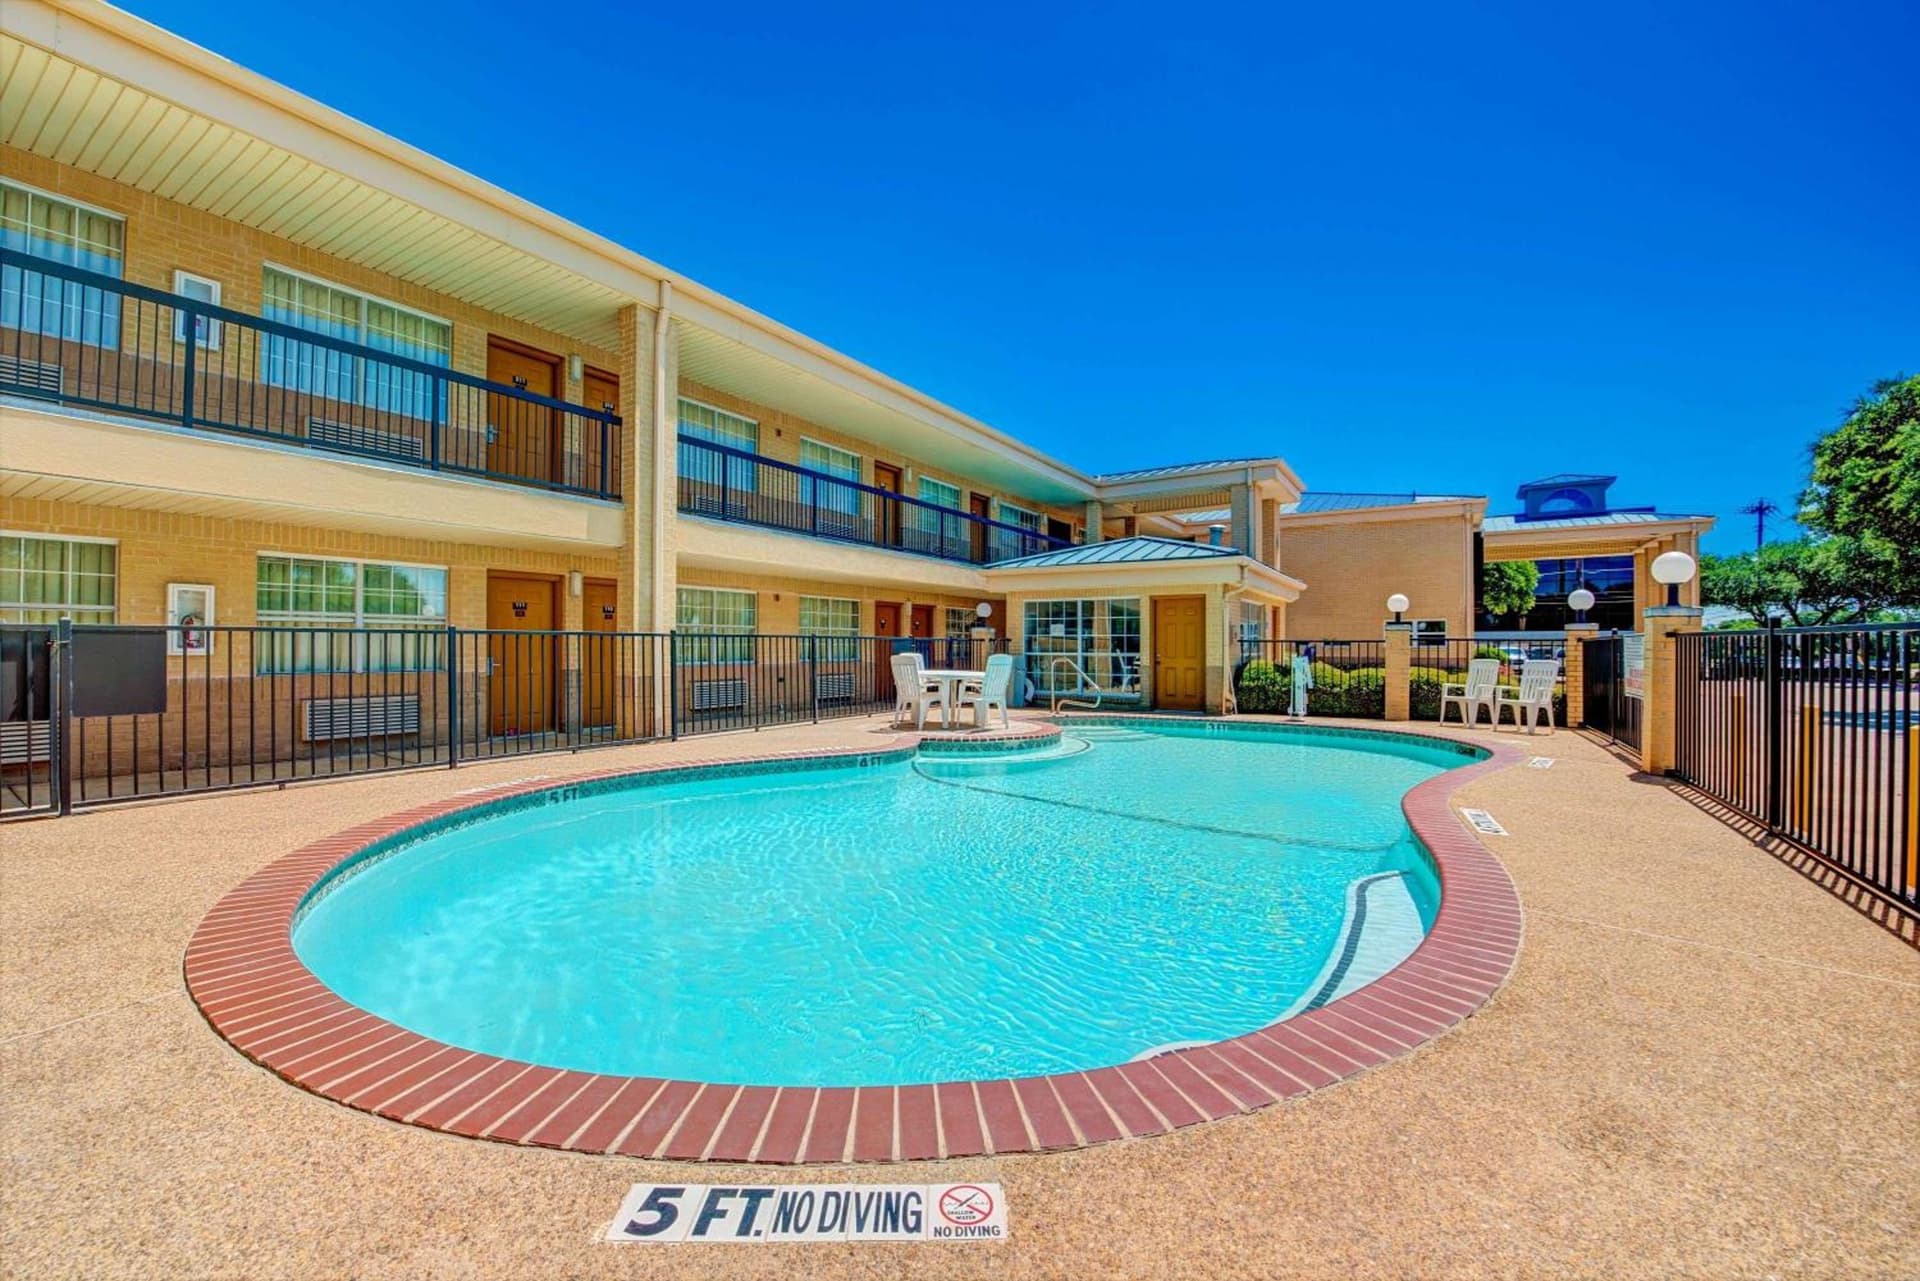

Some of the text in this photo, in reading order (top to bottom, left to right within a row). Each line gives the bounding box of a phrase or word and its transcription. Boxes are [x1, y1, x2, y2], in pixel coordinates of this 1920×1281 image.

[859, 756, 869, 768] 4
[550, 787, 578, 804] 5 FT
[623, 1187, 922, 1237] 5 FT. NO DIVING
[933, 1224, 1001, 1238] NO DIVING
